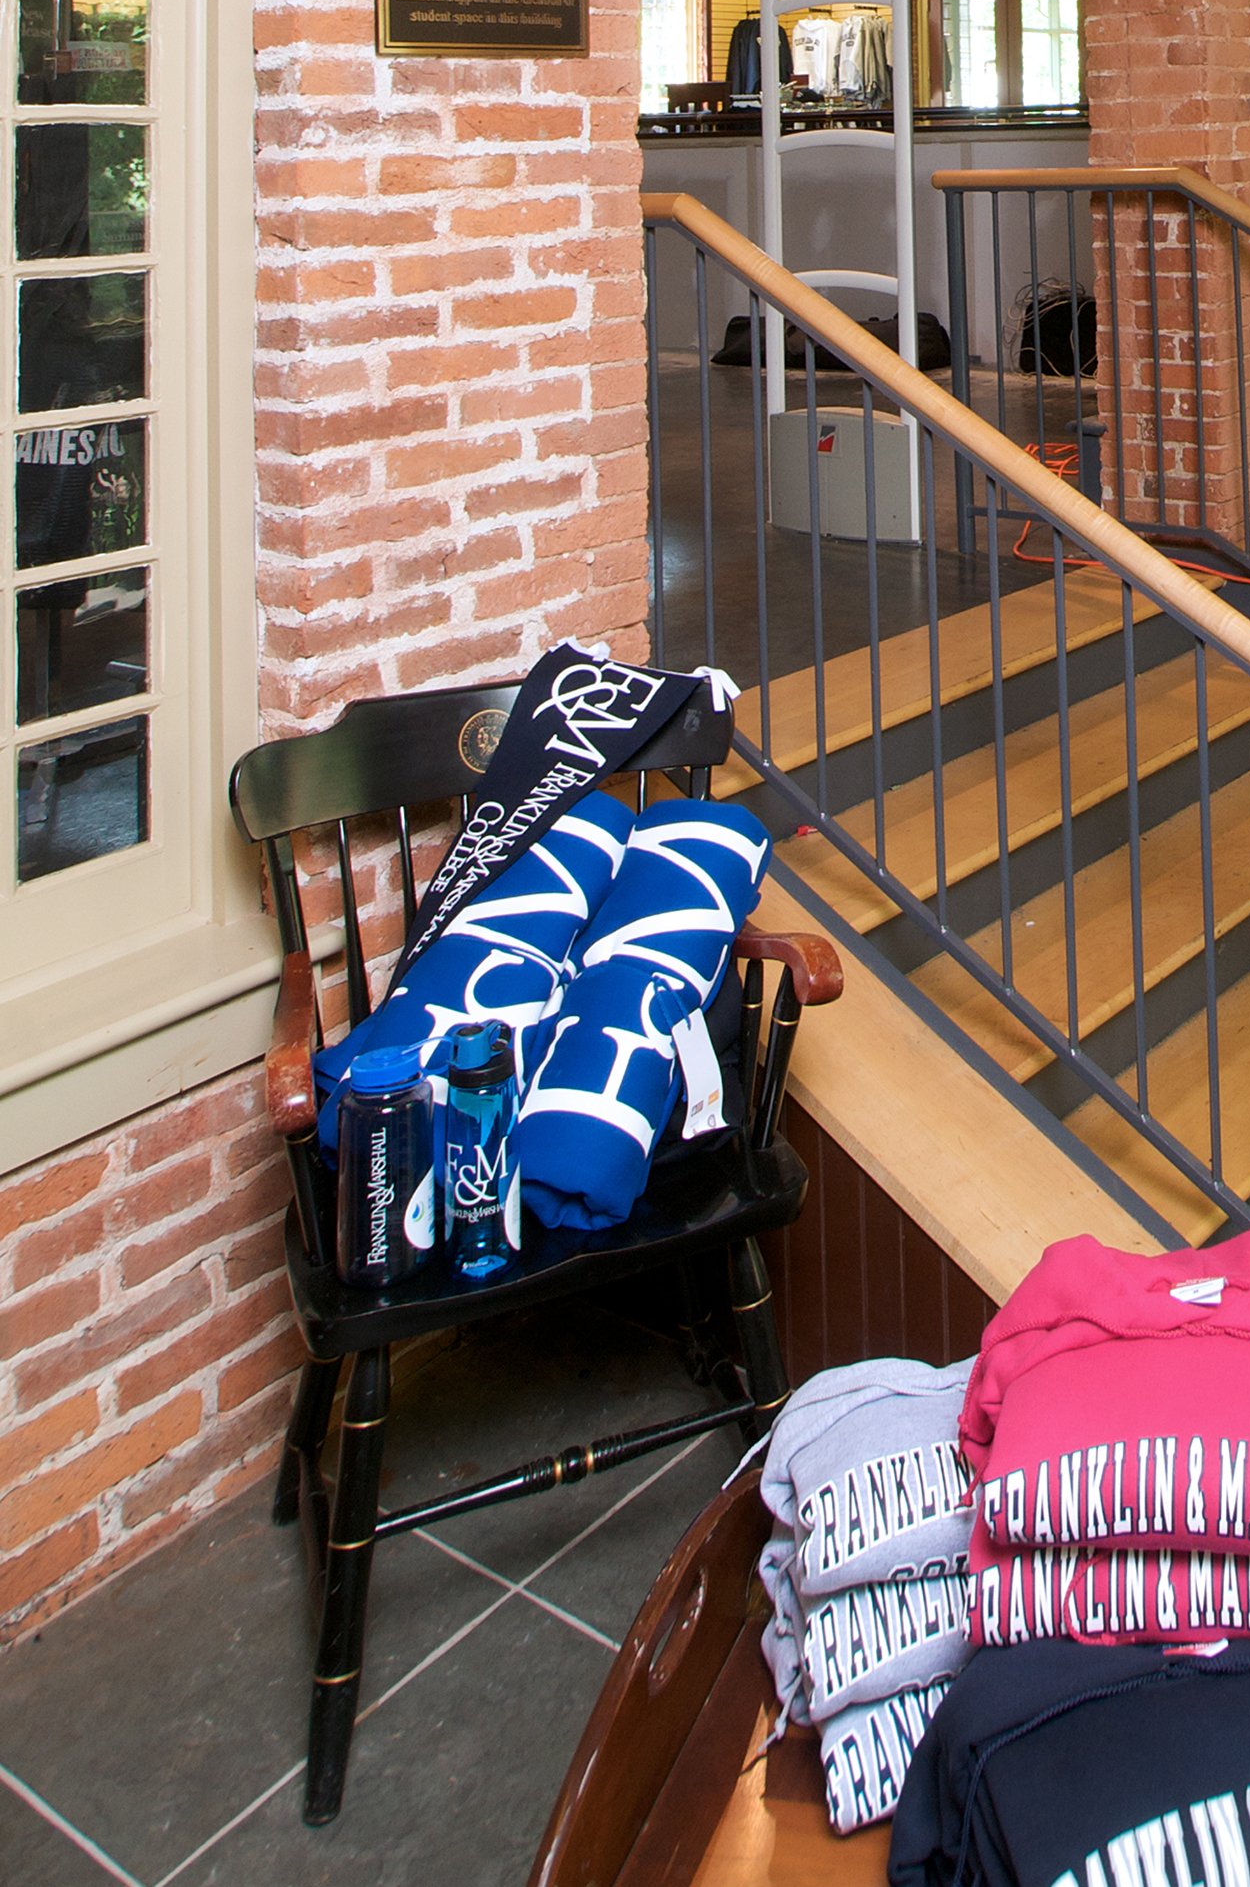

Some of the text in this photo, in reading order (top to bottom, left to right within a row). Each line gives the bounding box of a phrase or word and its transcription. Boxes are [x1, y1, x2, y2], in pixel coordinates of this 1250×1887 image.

[409, 10, 452, 22] student
[532, 663, 667, 769] F&M
[431, 801, 505, 893] COLLEGE
[446, 1136, 509, 1206] F&M
[984, 1436, 1178, 1544] FRANKLIN
[1186, 1435, 1208, 1535] &
[1157, 1548, 1179, 1632] &
